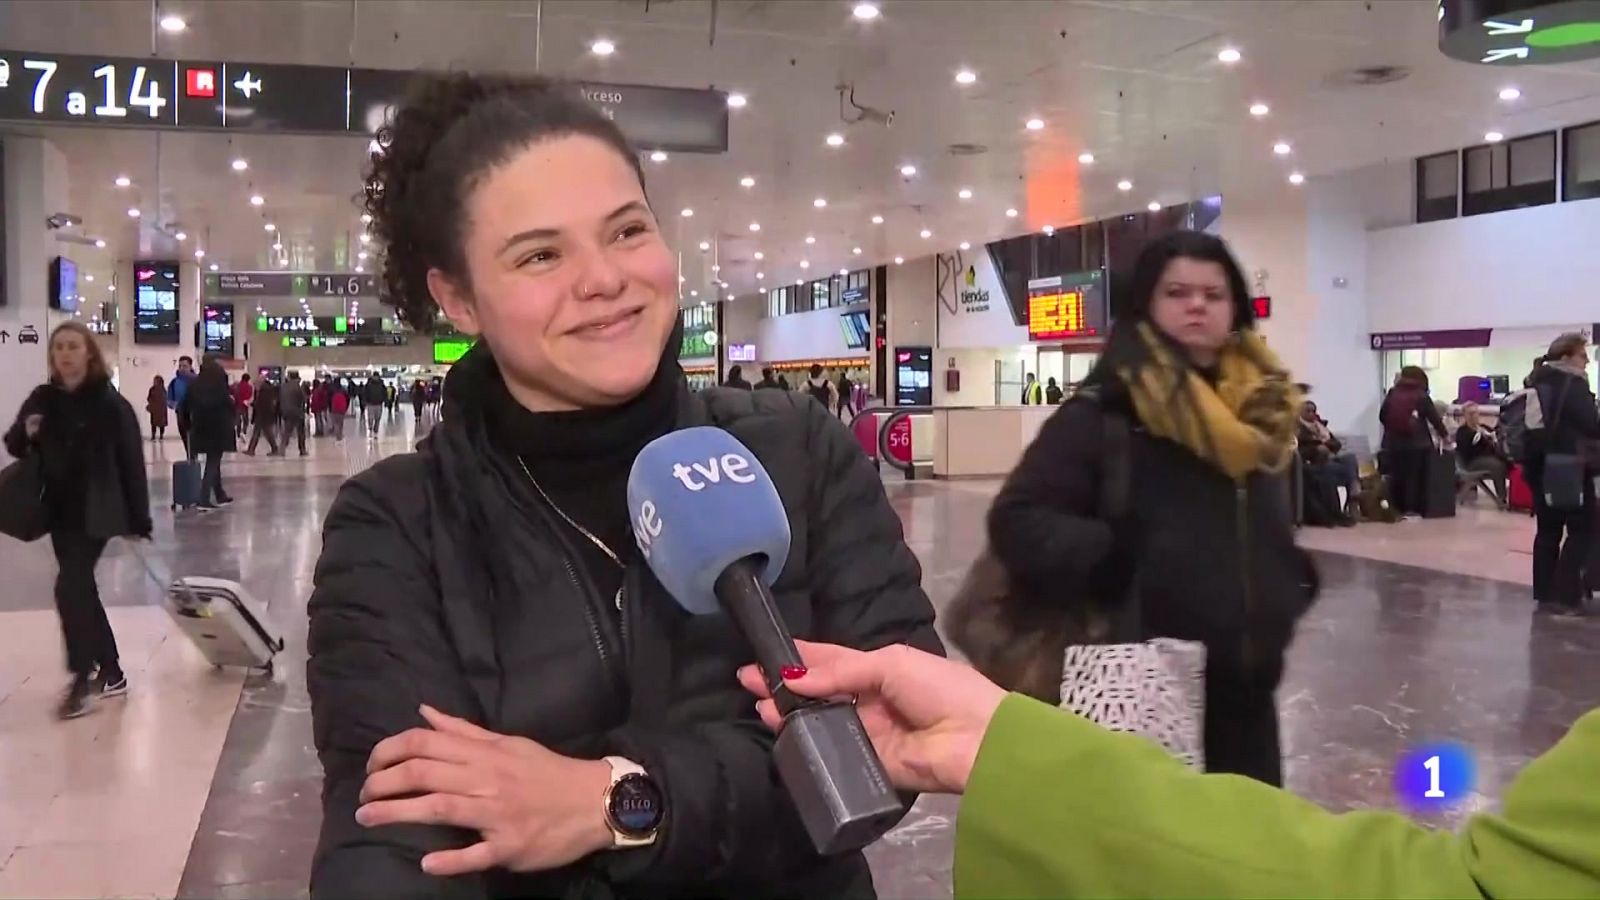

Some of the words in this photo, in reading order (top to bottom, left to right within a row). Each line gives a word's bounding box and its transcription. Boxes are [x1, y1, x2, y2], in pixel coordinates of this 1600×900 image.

[24, 60, 58, 113] 7
[66, 91, 86, 115] a
[93, 65, 166, 118] 14
[197, 70, 214, 90] R
[324, 277, 335, 294] 1
[348, 277, 360, 295] 6
[673, 453, 757, 491] tve
